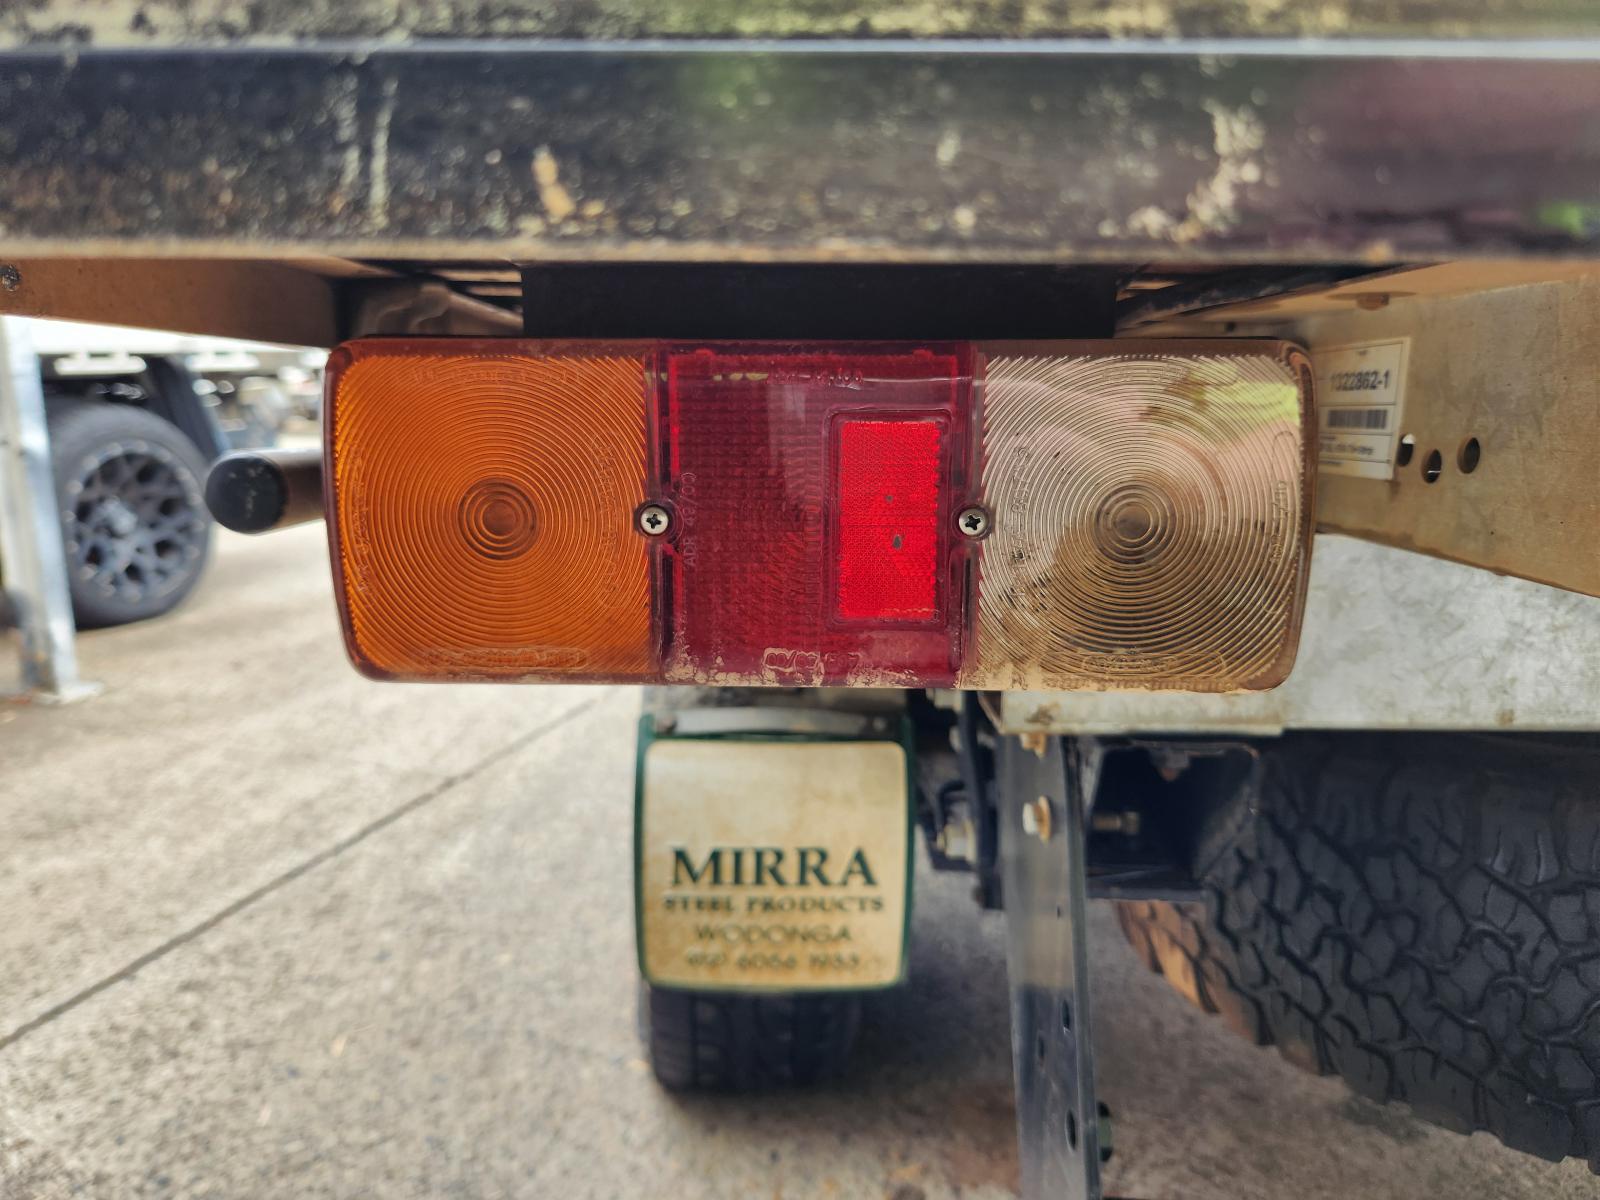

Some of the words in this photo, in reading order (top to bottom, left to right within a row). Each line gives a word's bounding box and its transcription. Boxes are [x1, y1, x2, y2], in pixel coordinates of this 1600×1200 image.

[672, 846, 877, 886] MIRRA
[664, 895, 736, 912] STEEL
[747, 896, 884, 912] PRODUCTS
